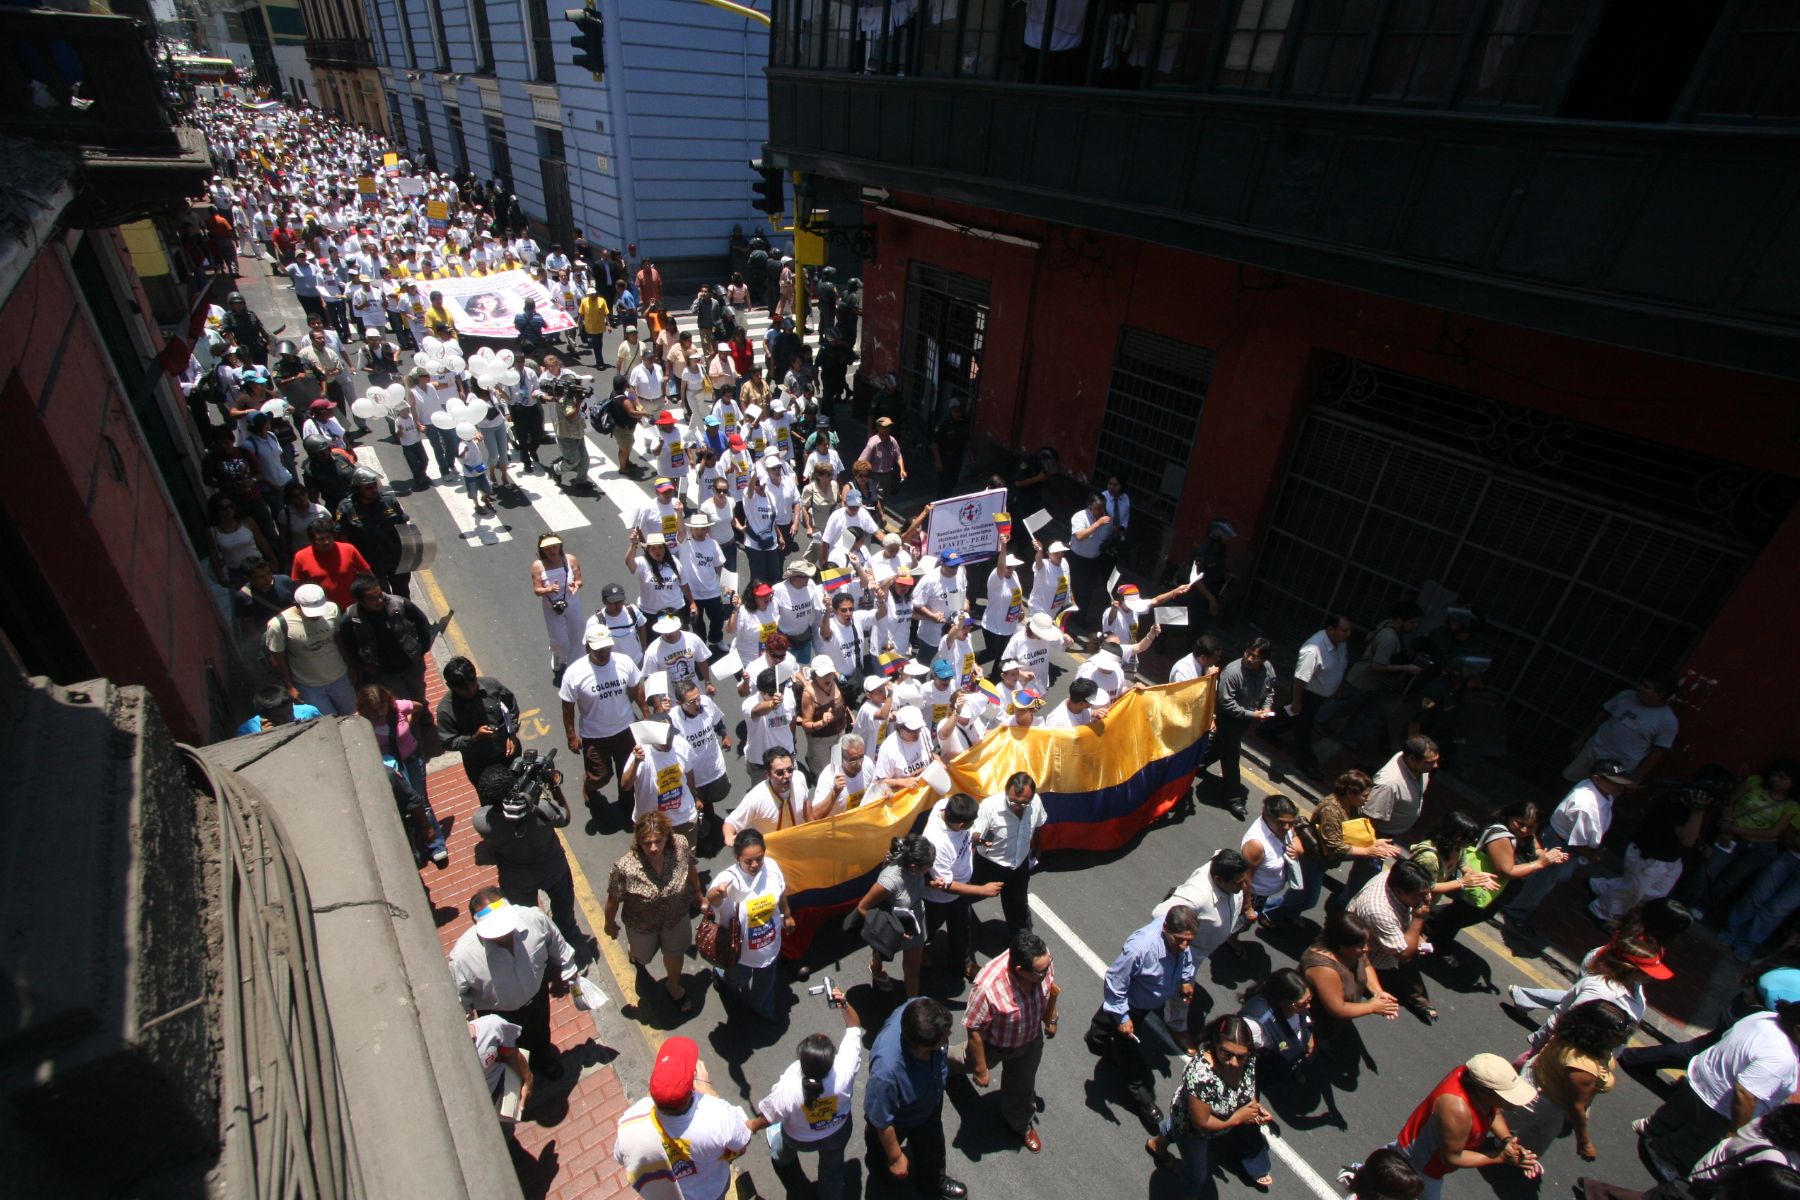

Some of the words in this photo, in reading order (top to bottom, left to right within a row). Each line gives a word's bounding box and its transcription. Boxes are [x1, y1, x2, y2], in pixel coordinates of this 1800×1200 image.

[591, 678, 627, 693] COLOMBIA
[599, 691, 612, 700] SOY
[693, 739, 705, 748] SOY
